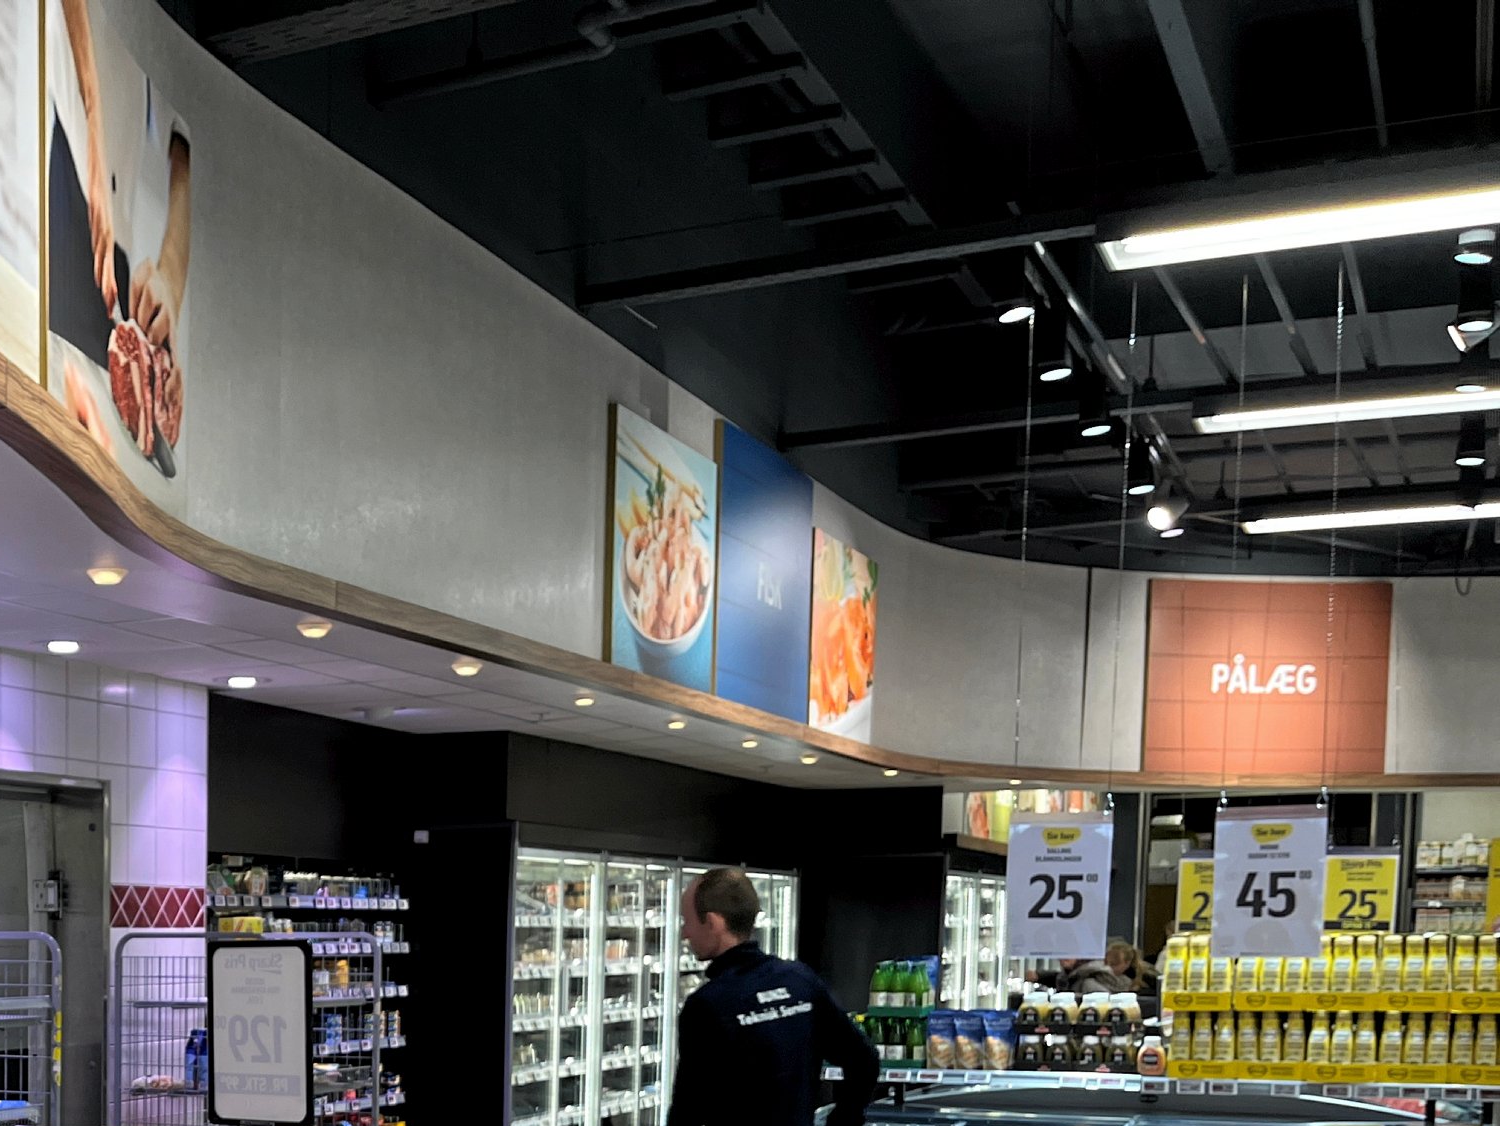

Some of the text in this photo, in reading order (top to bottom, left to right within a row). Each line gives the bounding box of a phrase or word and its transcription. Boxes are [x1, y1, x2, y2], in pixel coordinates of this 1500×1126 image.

[1211, 653, 1317, 695] PÅLÆG
[1028, 873, 1084, 919] 25
[1192, 891, 1211, 921] 2
[1236, 871, 1297, 918] 45
[1338, 889, 1378, 920] 25
